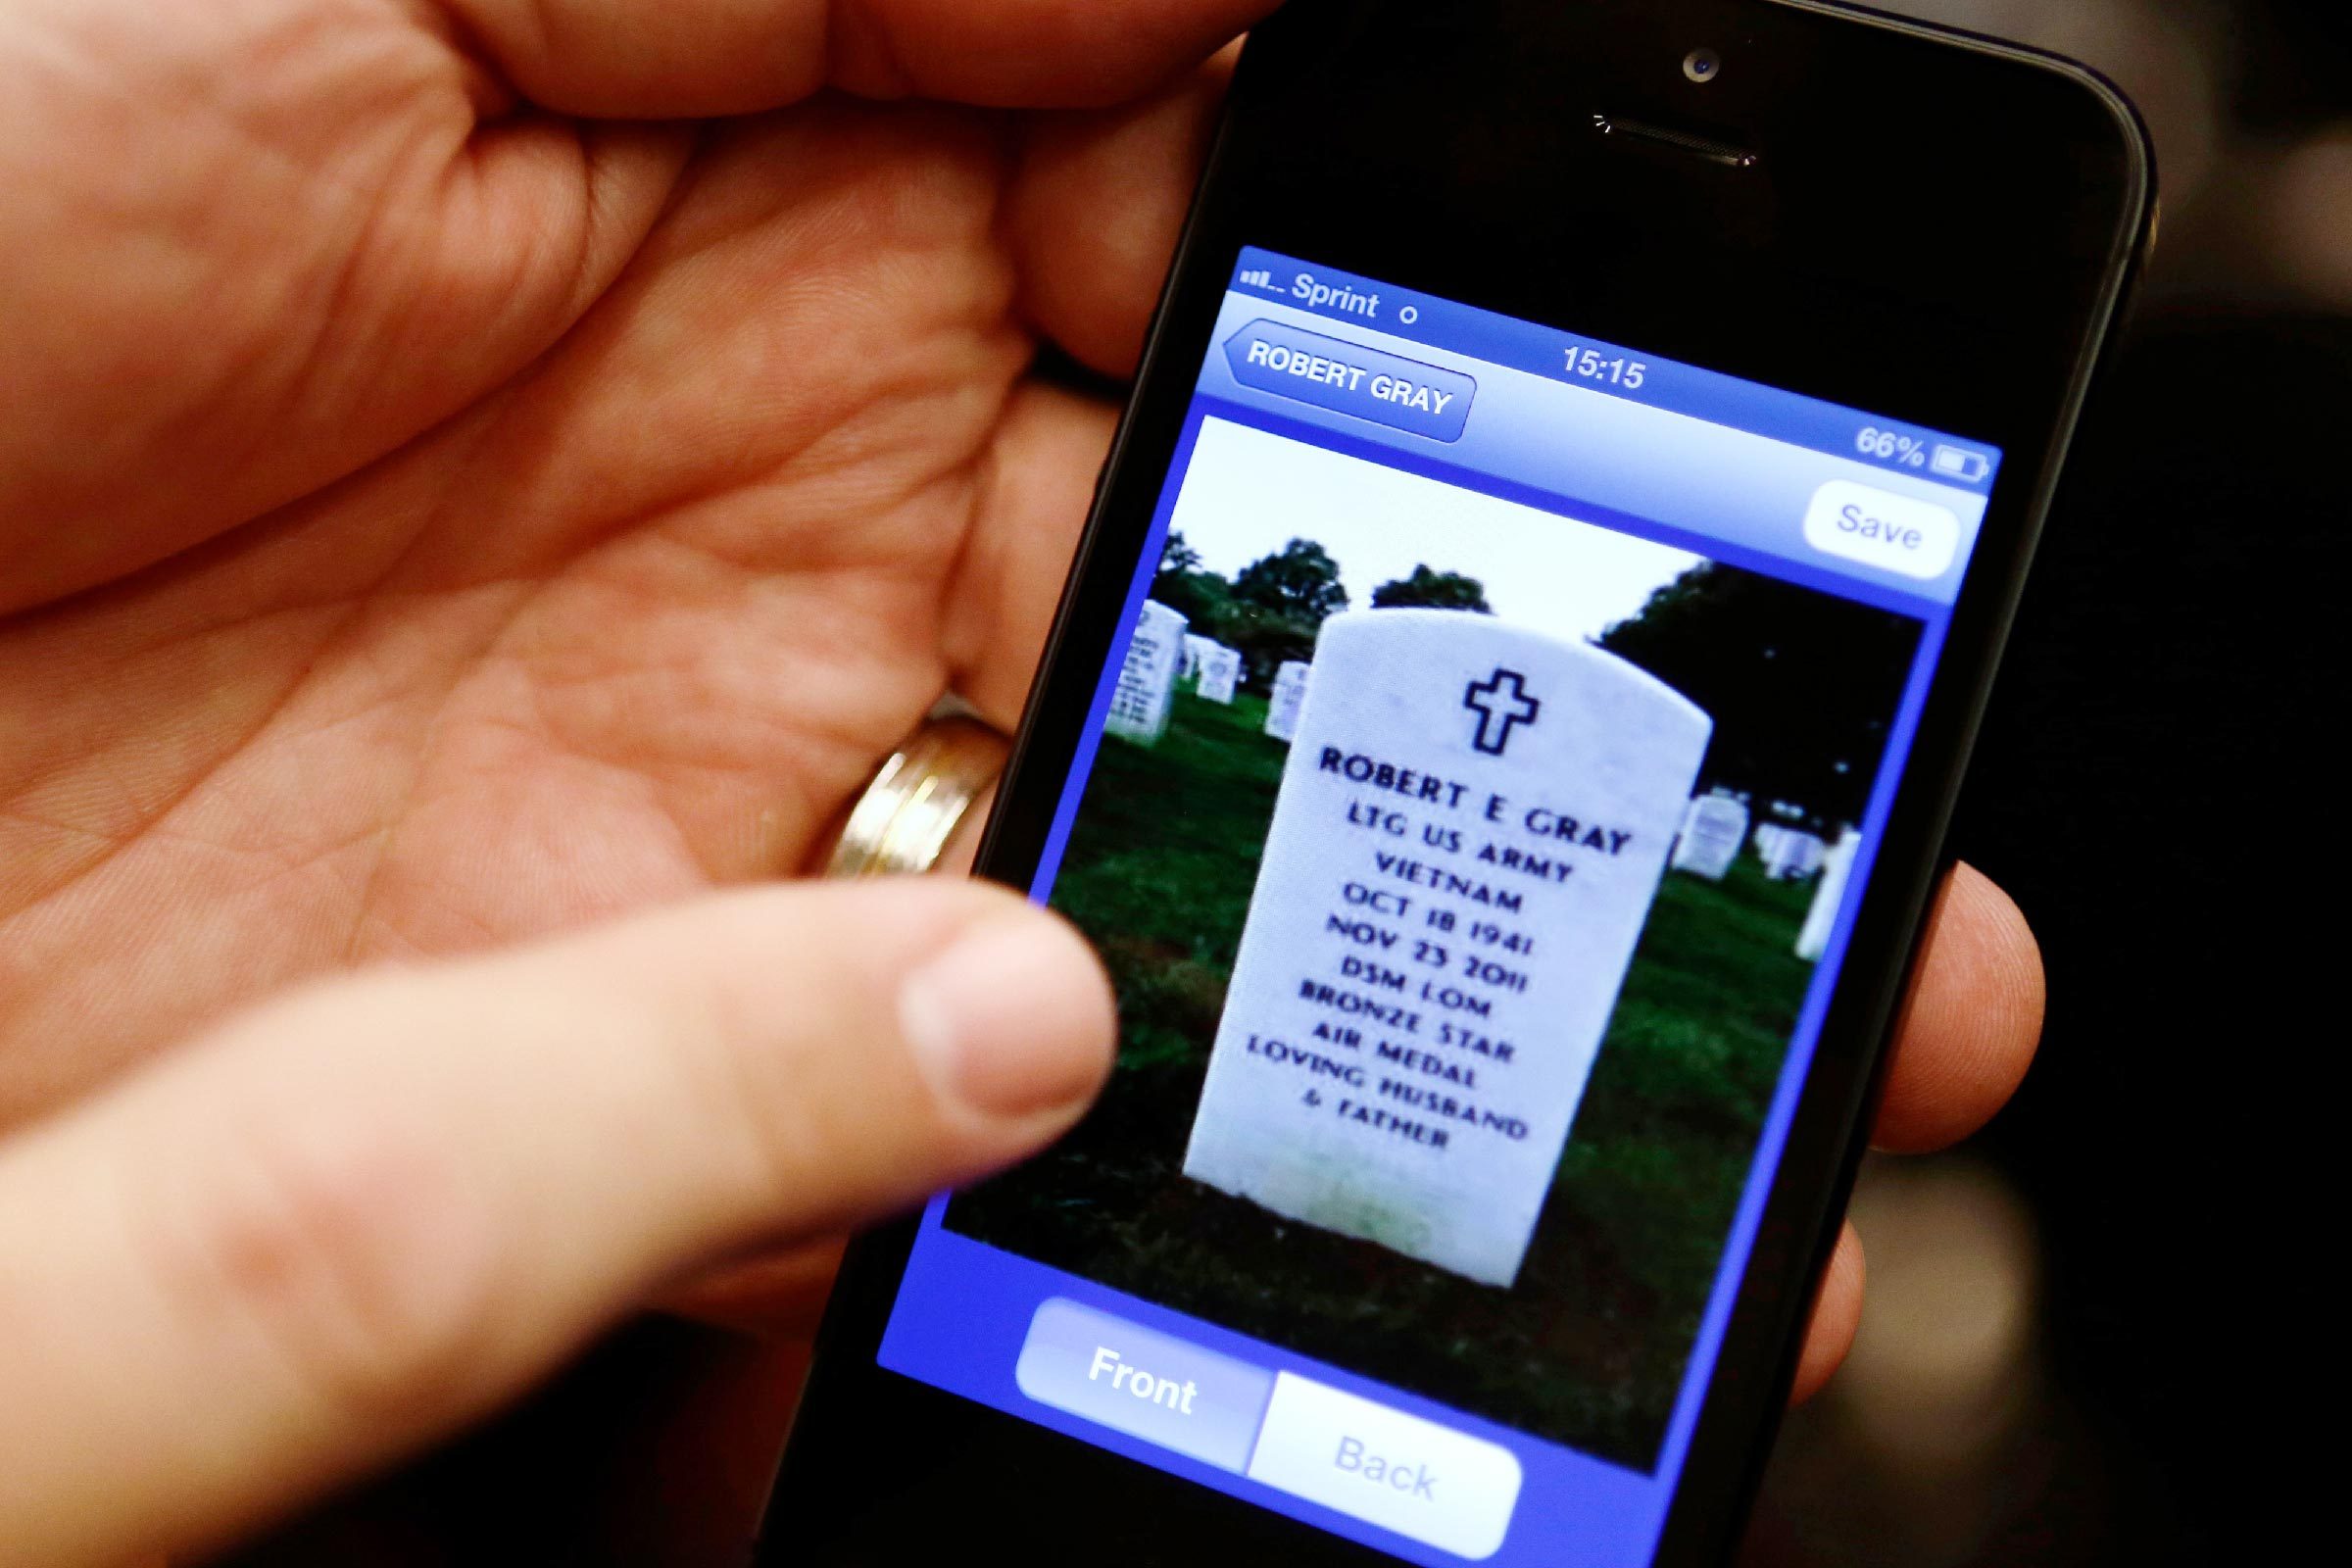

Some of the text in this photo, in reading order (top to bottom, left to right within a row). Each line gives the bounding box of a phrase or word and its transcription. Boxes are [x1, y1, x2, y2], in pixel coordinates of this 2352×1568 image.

[1292, 273, 1379, 318] Sprint
[1248, 340, 1452, 415] ROBERT GRAY
[1564, 346, 1646, 388] 15:15
[1856, 426, 1925, 466] 66%
[1837, 504, 1923, 549] Save
[1320, 747, 1632, 856] ROBERT E GRAY
[1348, 800, 1573, 883] LTG US ARMY
[1376, 851, 1523, 911] VIETNAM
[1326, 914, 1528, 992] NOV 23 2011
[1344, 882, 1533, 956] OCT 18 1941
[1298, 979, 1516, 1063] BRONZE STAR
[1341, 955, 1493, 1018] DSM LOM
[1248, 1034, 1529, 1140] LOVING HUSBAND
[1313, 1022, 1477, 1089] AIR MEDAL
[1339, 1099, 1449, 1149] FATHER
[1088, 1347, 1441, 1502] Front Back
